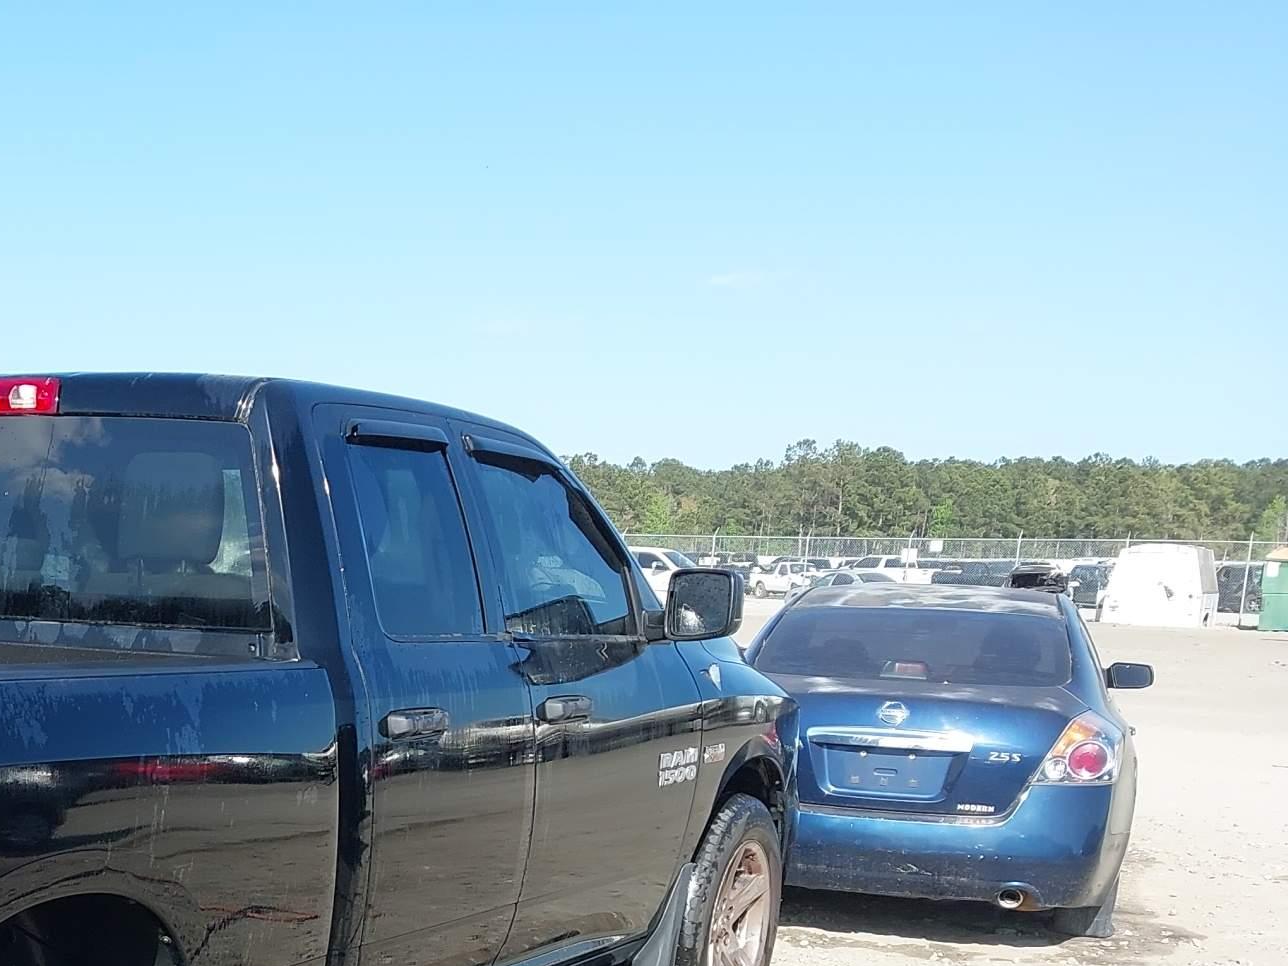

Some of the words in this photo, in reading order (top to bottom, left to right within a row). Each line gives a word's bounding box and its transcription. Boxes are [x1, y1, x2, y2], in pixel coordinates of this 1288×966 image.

[659, 747, 698, 770] RAM
[658, 762, 697, 788] 1500
[956, 803, 995, 813] MODERN
